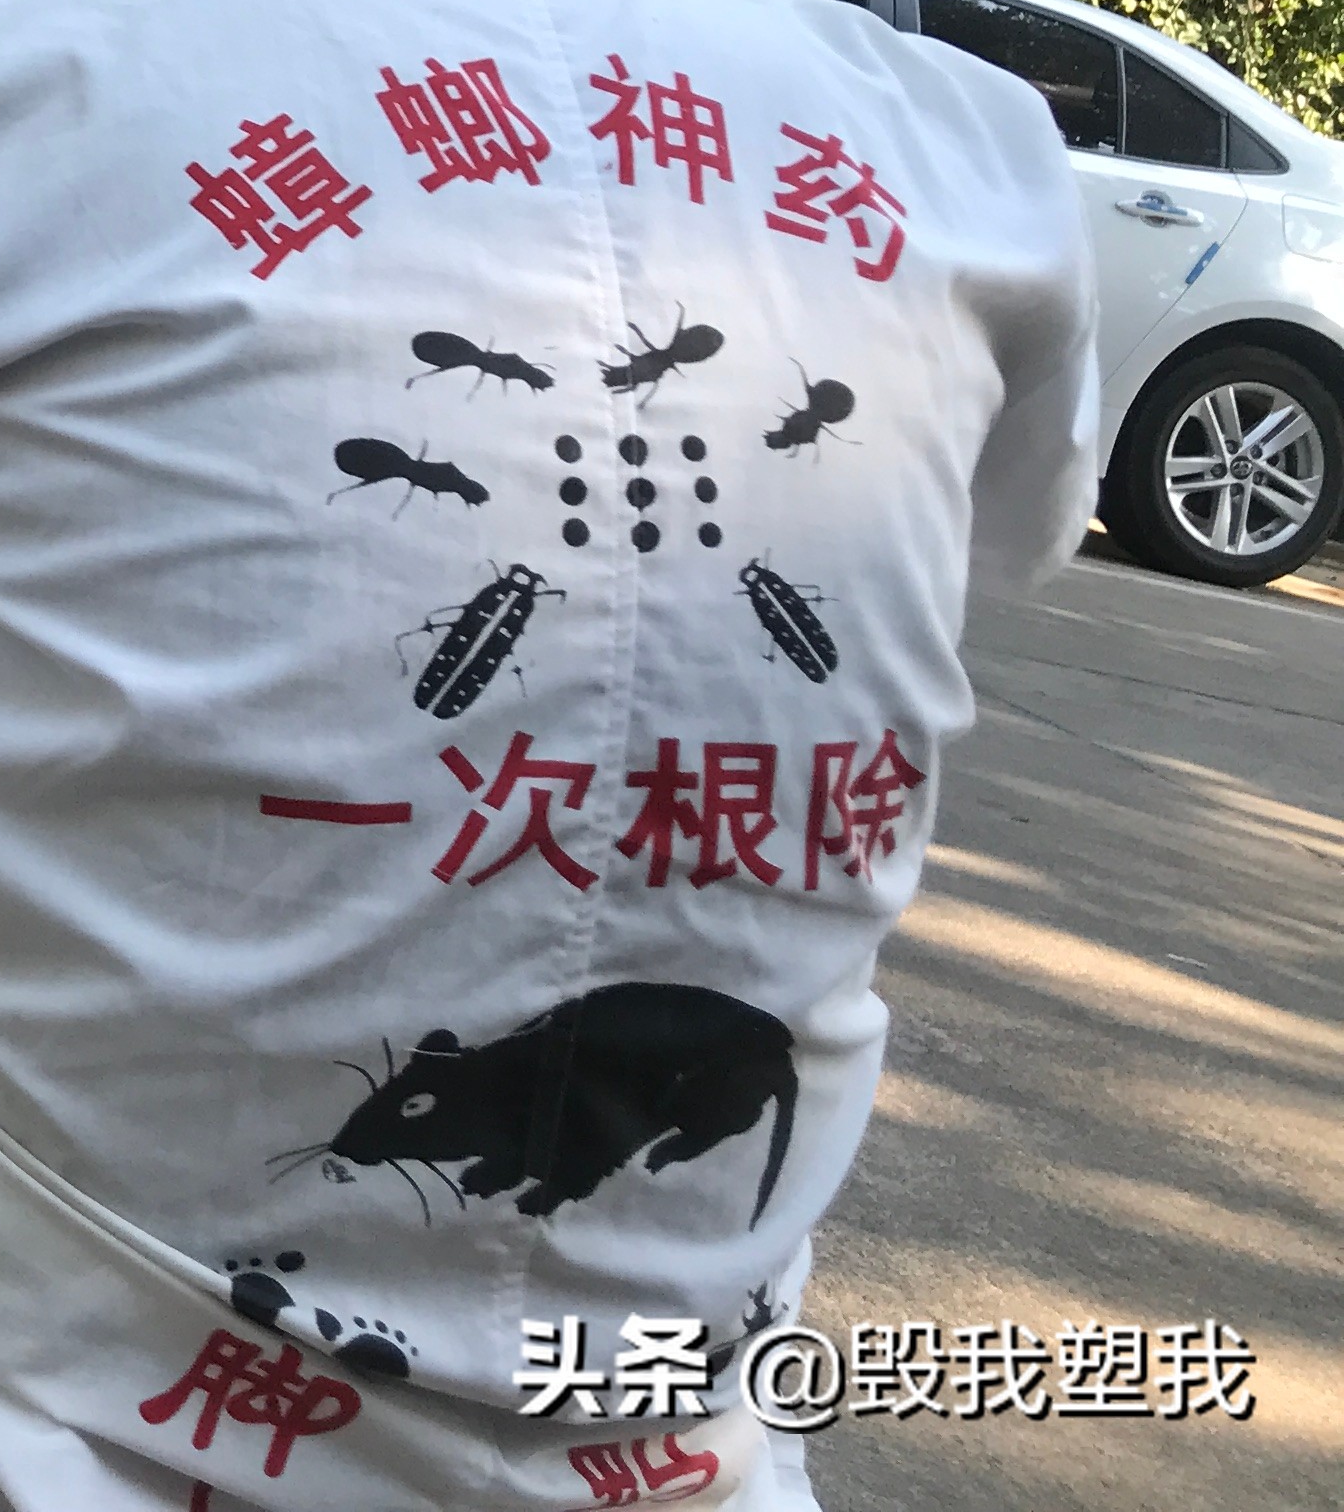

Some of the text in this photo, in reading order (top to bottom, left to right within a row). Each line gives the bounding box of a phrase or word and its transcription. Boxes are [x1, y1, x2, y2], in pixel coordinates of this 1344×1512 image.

[187, 53, 909, 282] 蟑螂神药
[258, 727, 926, 892] 一次根除
